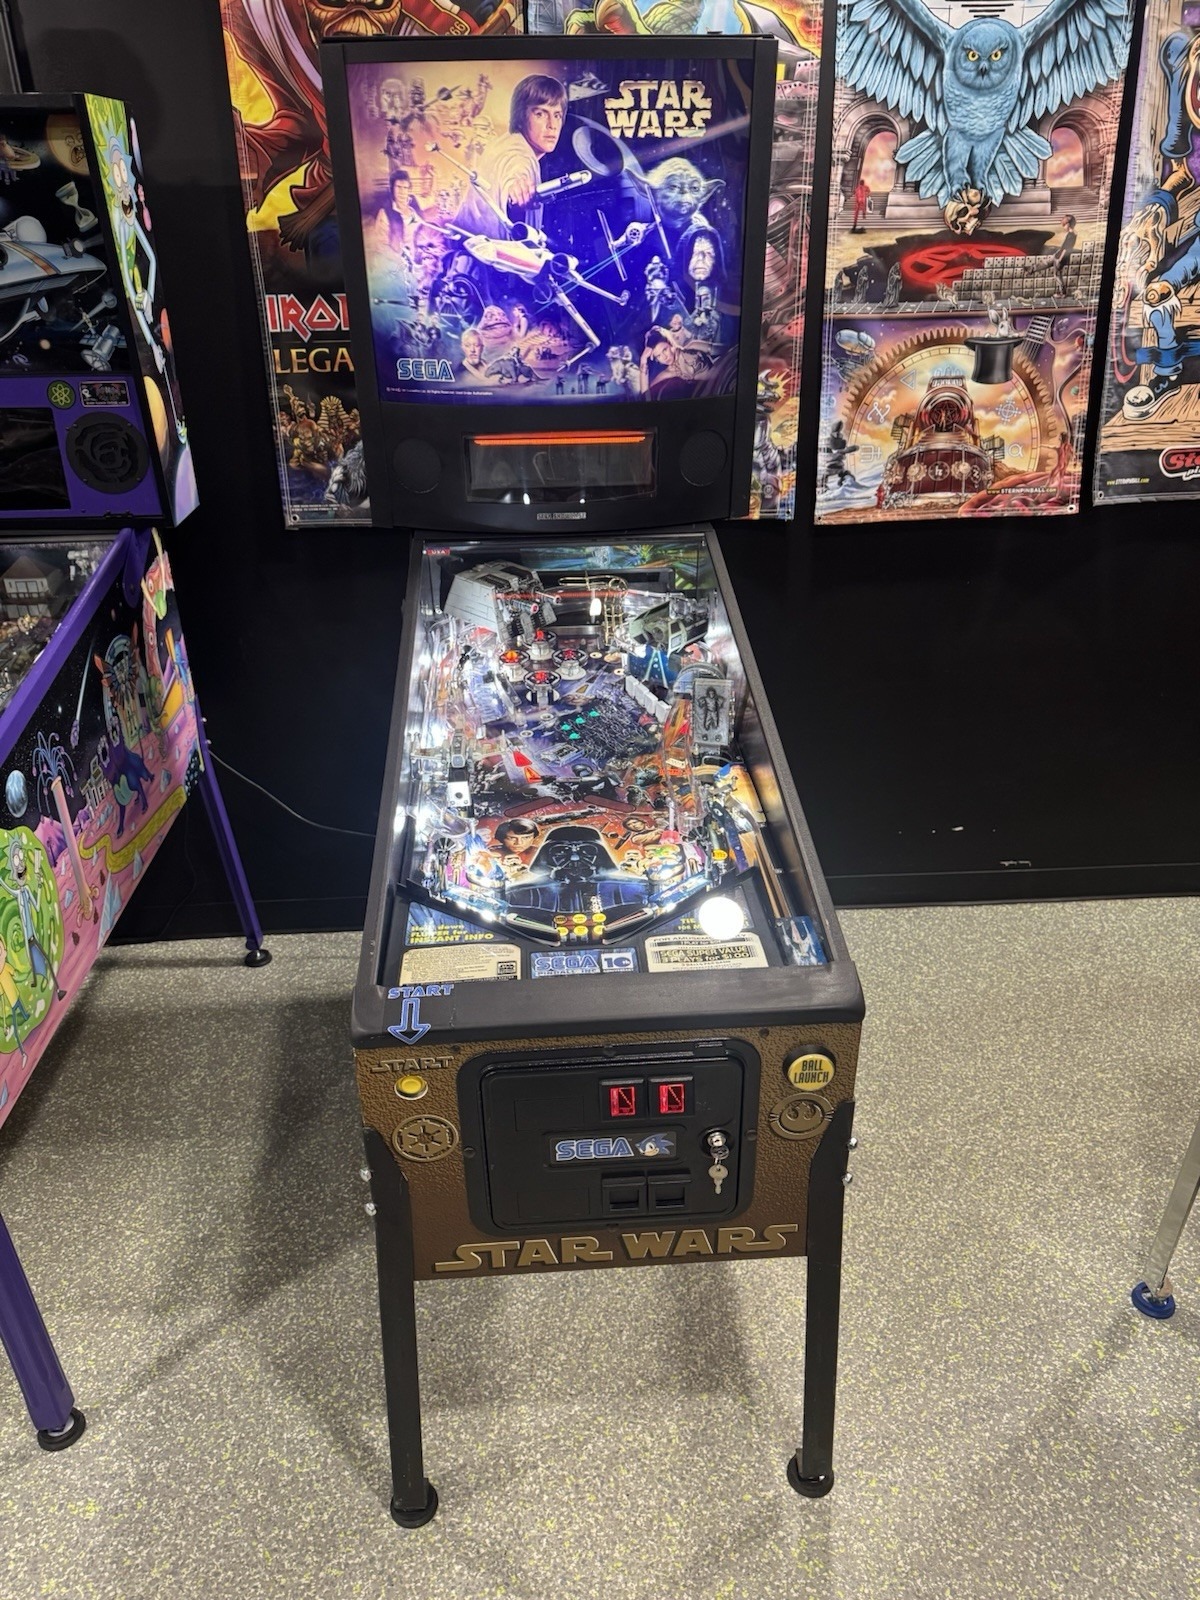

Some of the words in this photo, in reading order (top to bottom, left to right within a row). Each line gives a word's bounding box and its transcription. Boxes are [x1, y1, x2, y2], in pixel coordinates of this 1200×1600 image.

[604, 80, 712, 109] STAR
[605, 110, 711, 138] WARS
[397, 358, 455, 382] SEGA
[465, 933, 494, 941] INFO
[687, 948, 717, 956] SUPER
[719, 945, 747, 954] VALUE
[535, 955, 600, 970] SEGA
[388, 984, 454, 999] START
[371, 1056, 454, 1073] START
[802, 1059, 823, 1071] BALL
[794, 1071, 829, 1083] LAUNCH
[556, 1137, 634, 1161] SEGA
[434, 1237, 613, 1273] STAR
[621, 1224, 798, 1259] WARS
